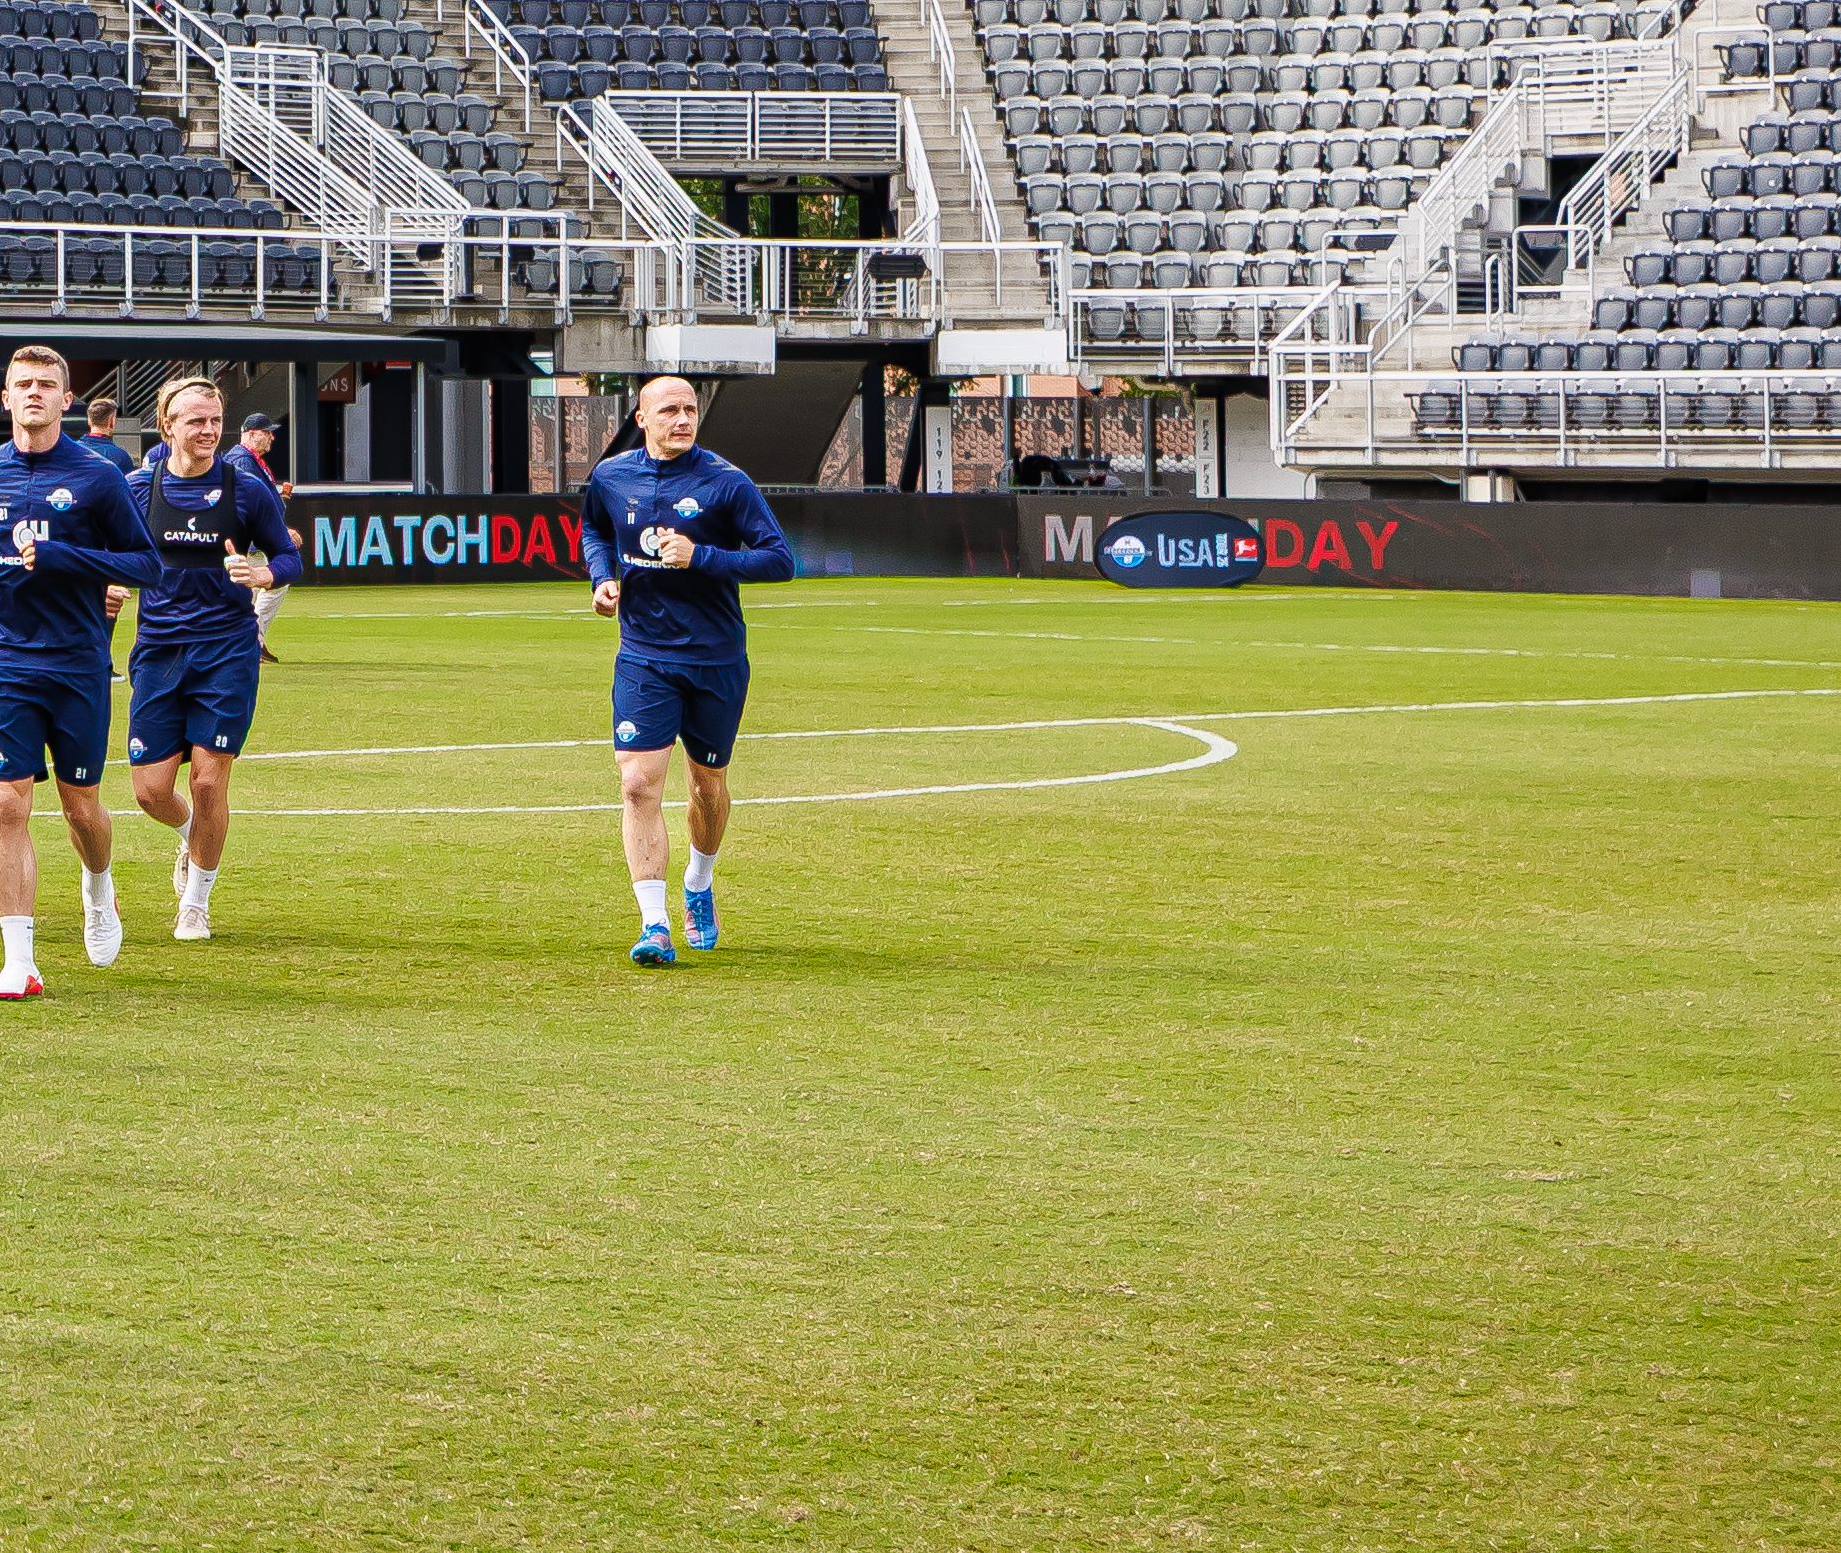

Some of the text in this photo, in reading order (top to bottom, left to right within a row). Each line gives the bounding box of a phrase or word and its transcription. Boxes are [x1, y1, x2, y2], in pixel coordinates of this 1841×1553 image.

[163, 531, 219, 543] CATAPULT
[314, 514, 583, 567] MATCHDAY
[1156, 532, 1214, 568] USA
[75, 767, 87, 780] 21
